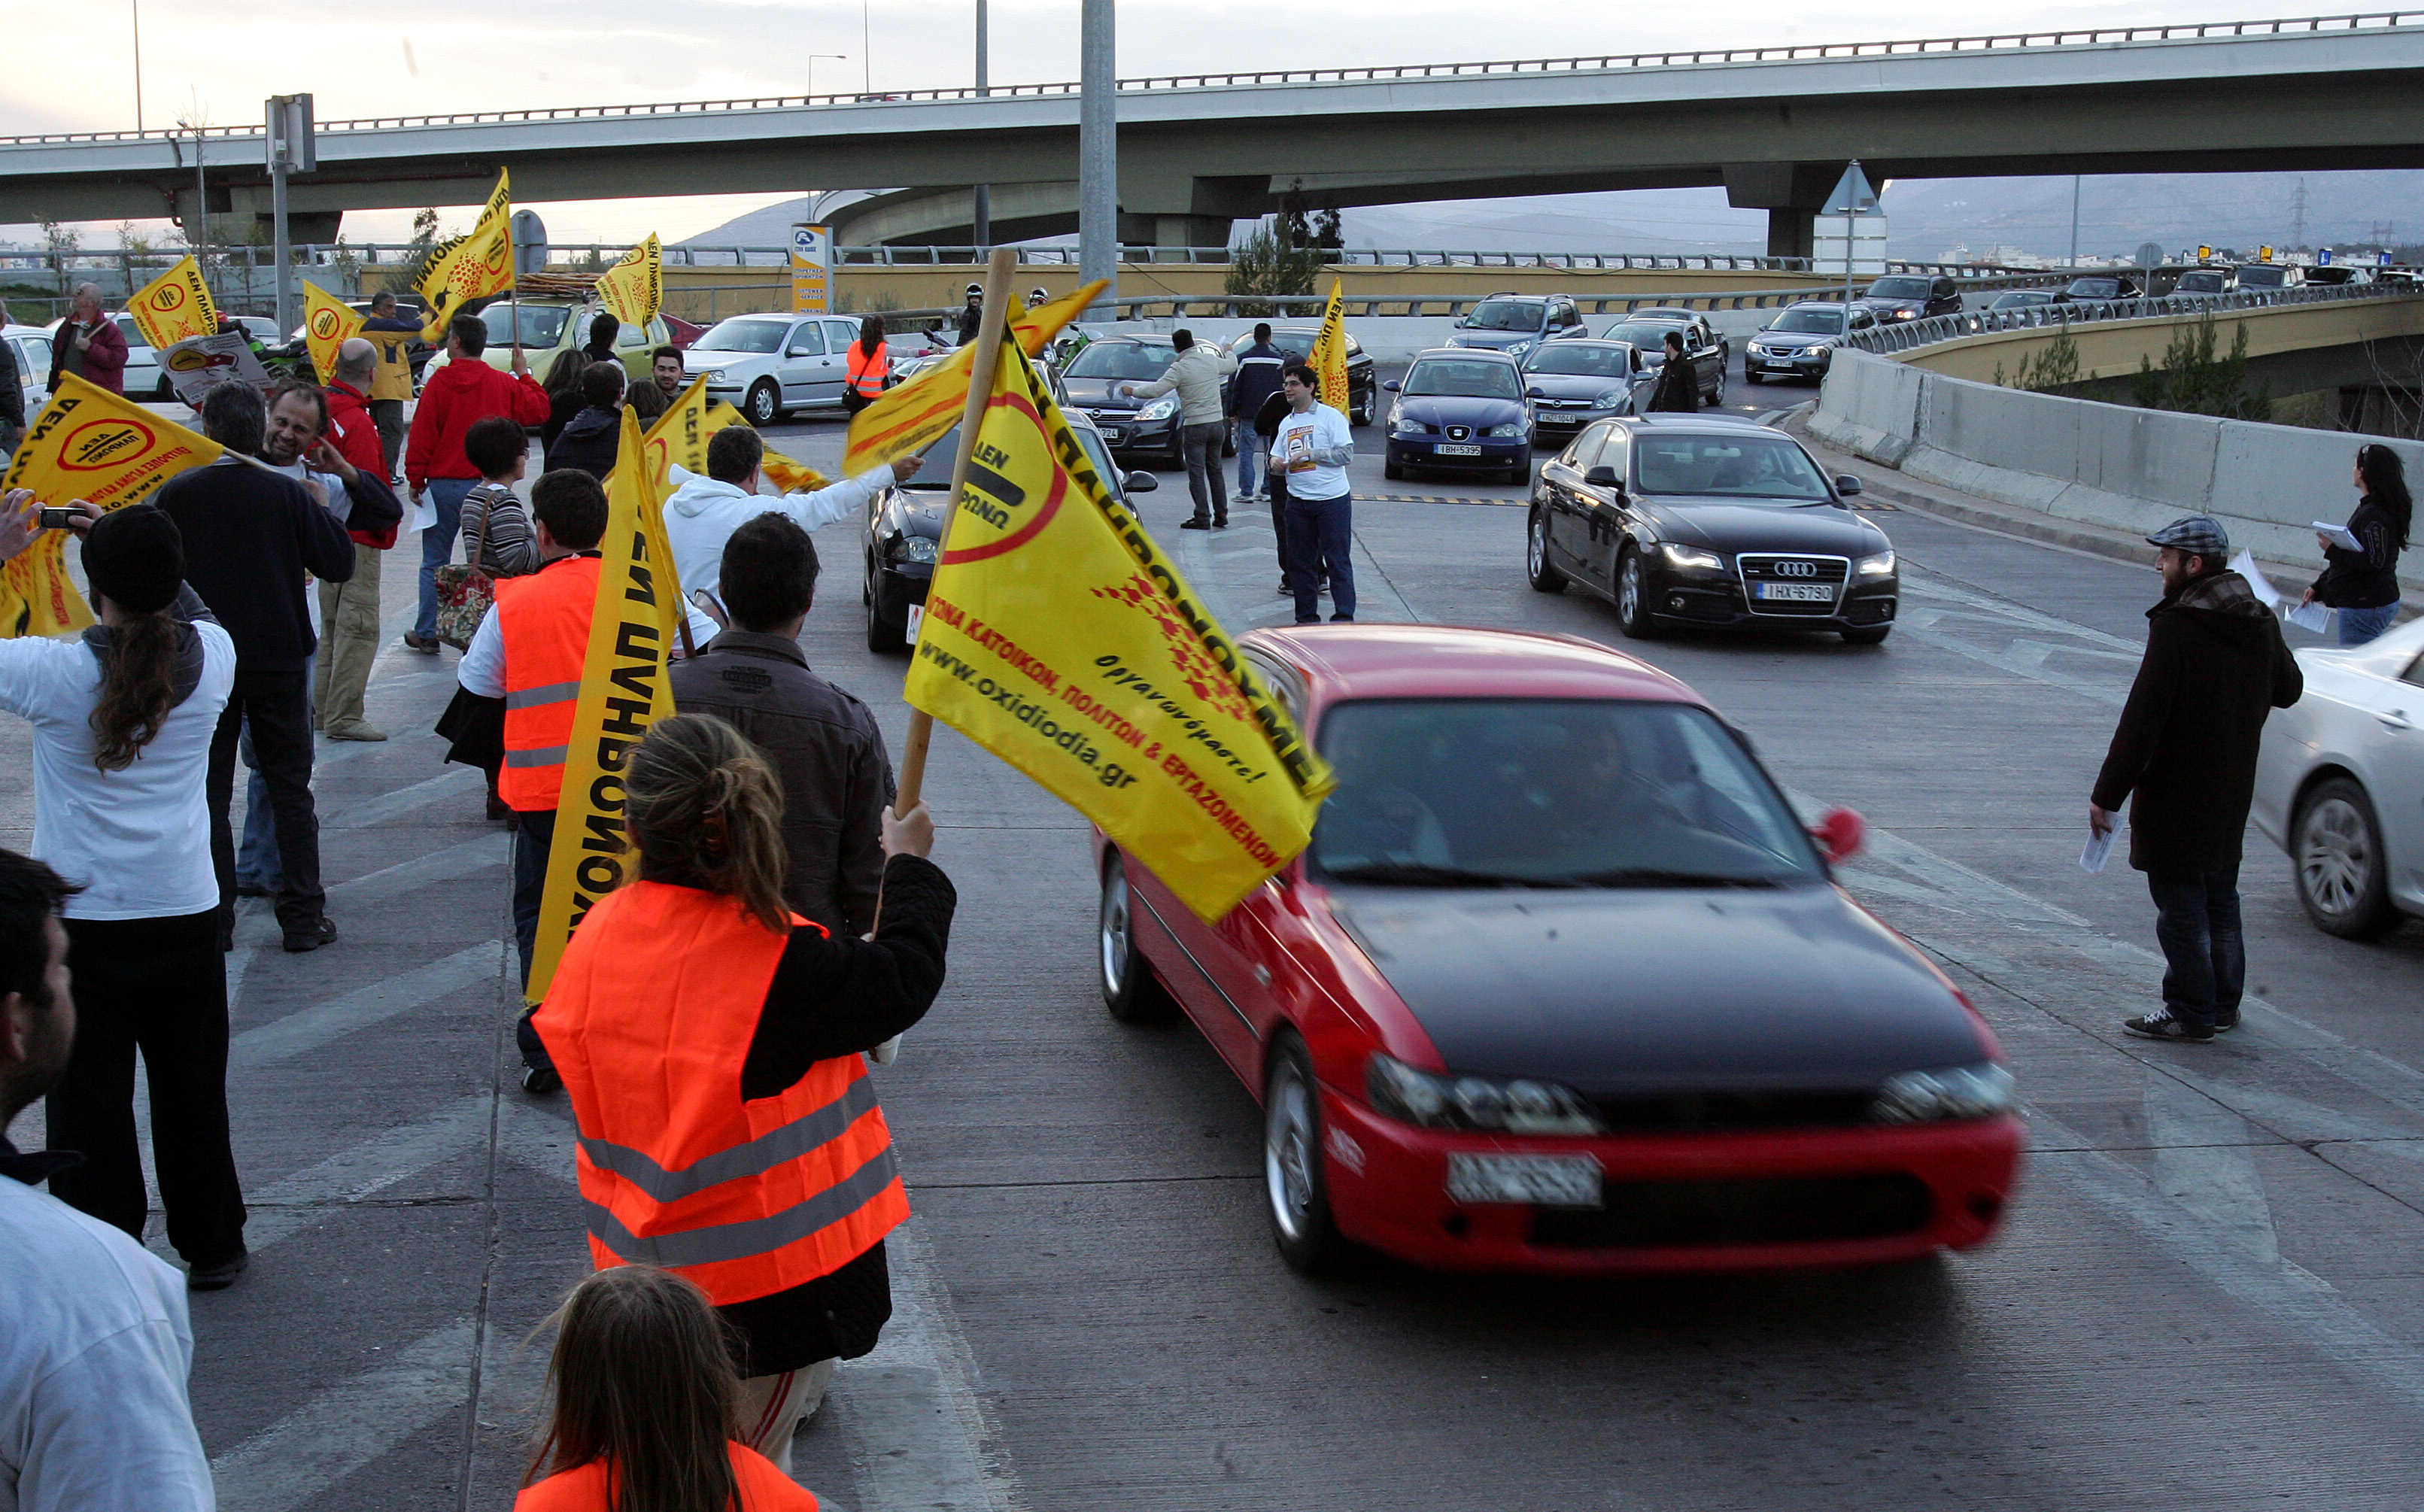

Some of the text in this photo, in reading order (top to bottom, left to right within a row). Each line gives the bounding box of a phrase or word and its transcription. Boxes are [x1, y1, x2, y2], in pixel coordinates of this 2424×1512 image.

[187, 271, 202, 293] ΔΕΝ
[961, 490, 1009, 530] ΡΩΝΩ
[919, 639, 1138, 789] www.oxidiodia.gr
[1060, 685, 1148, 748] ΠΟΛΙΤΩΝ
[1144, 742, 1163, 761] &
[1161, 753, 1282, 869] ΕΡΓΑΖΟΜΕΝΩΝ
